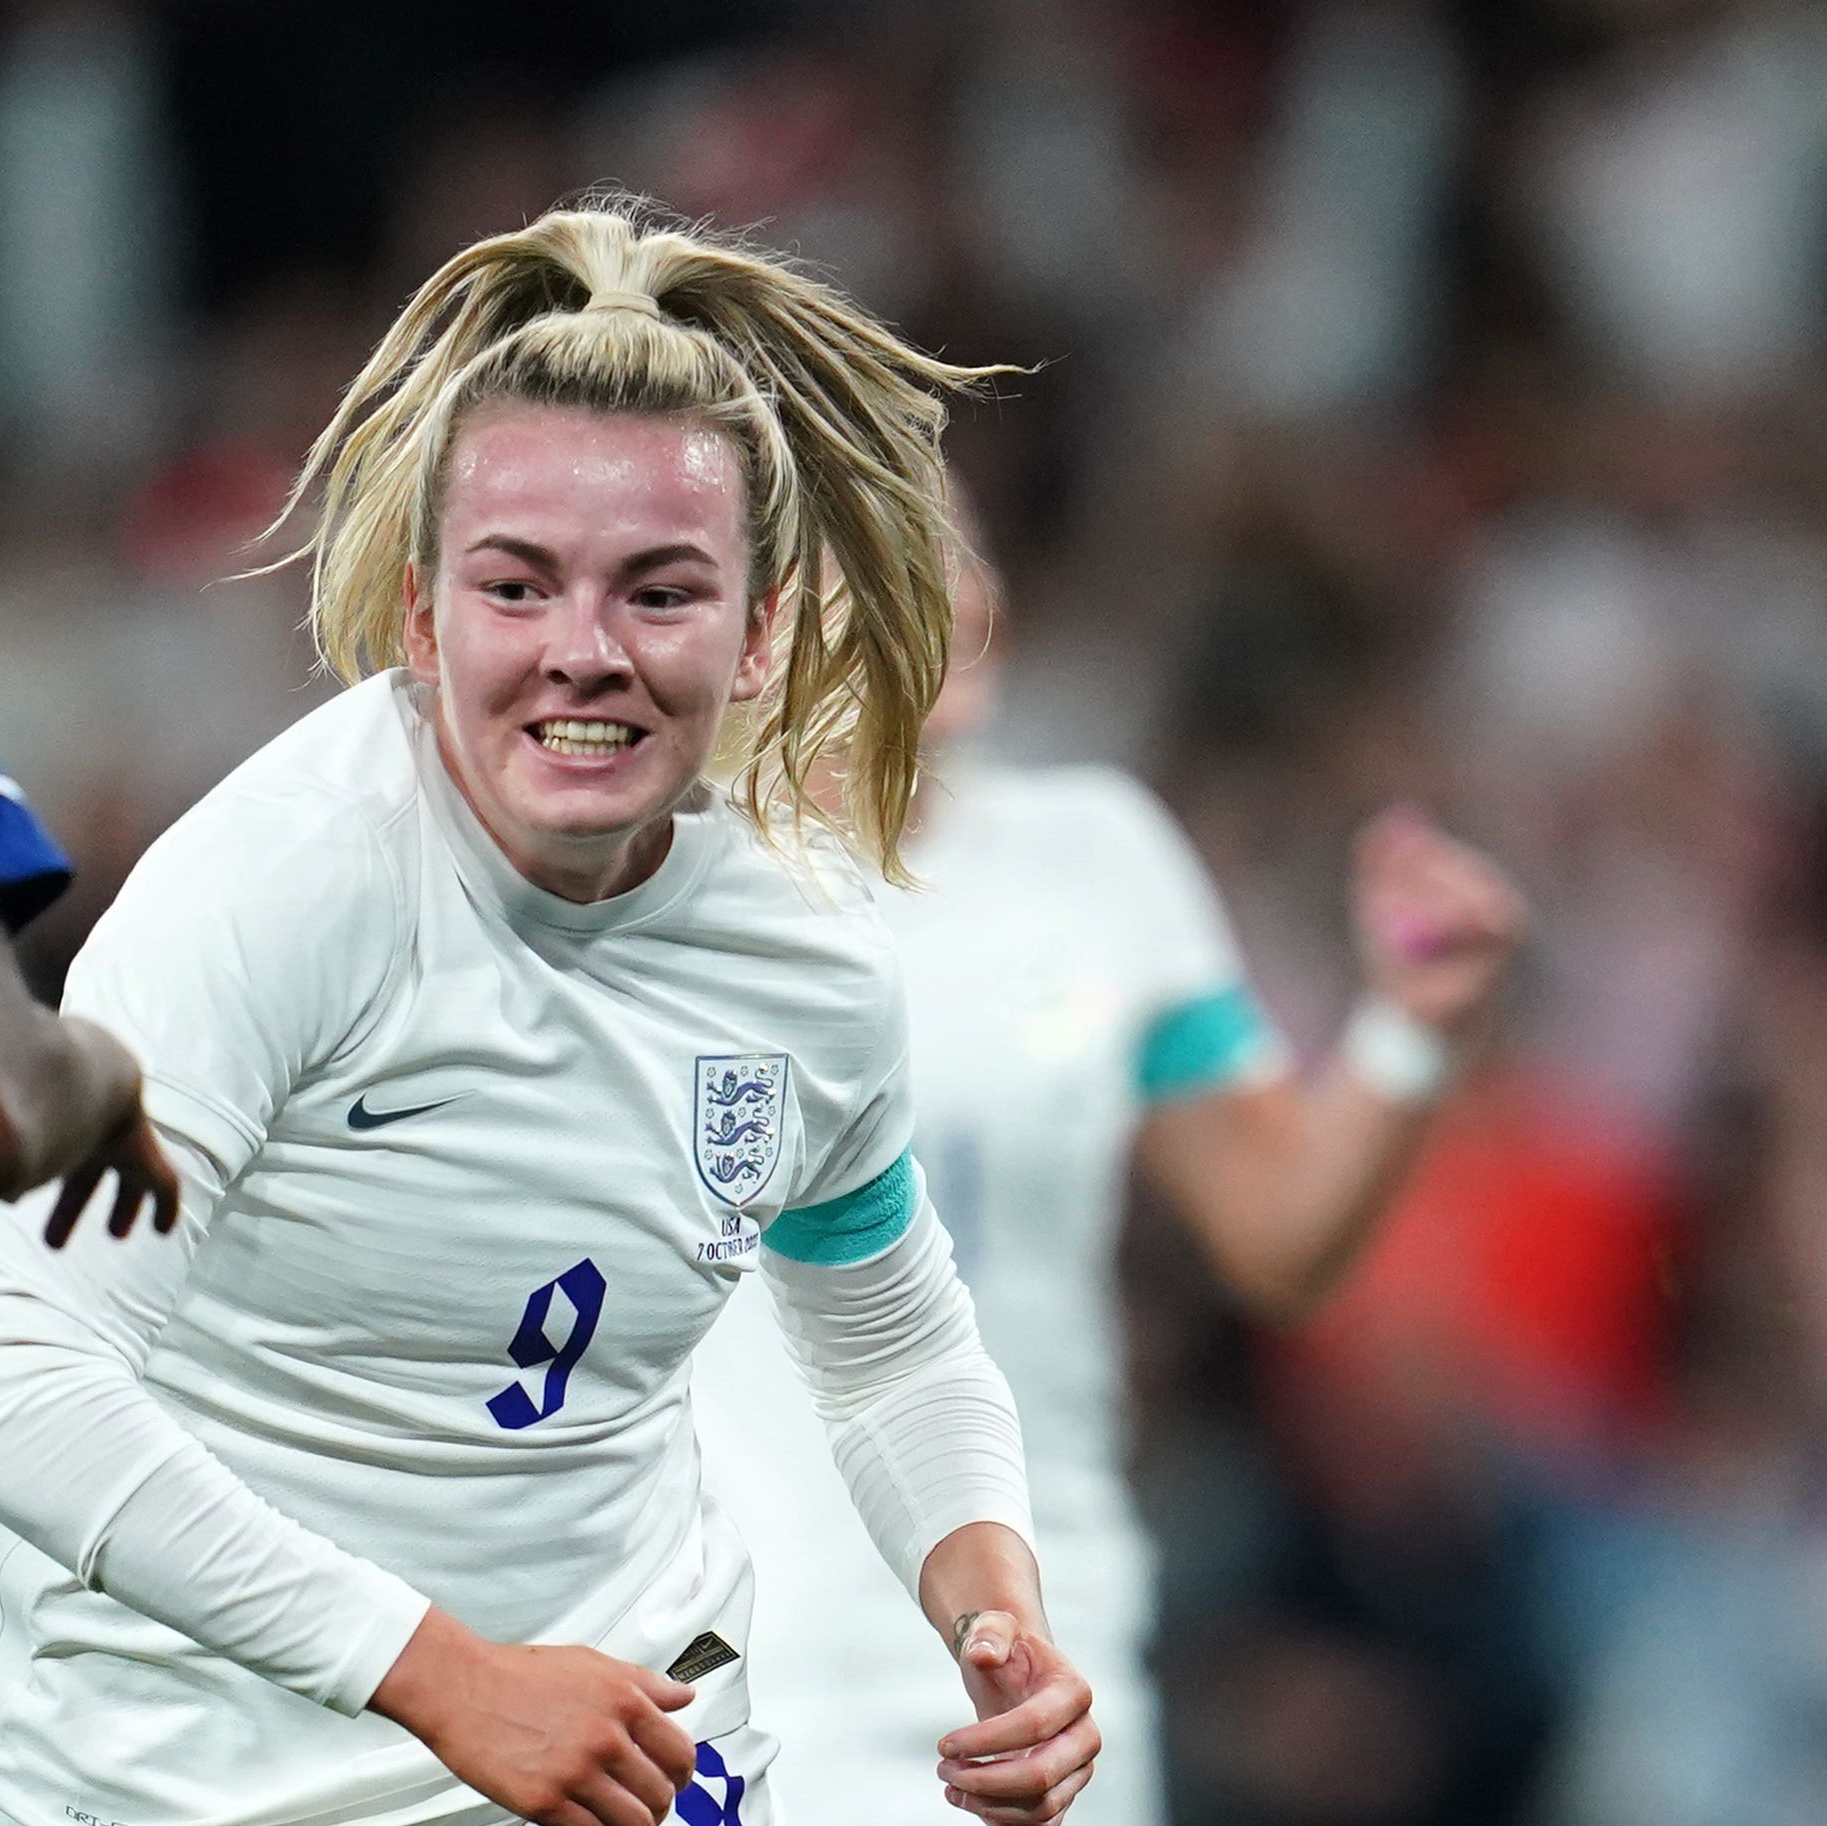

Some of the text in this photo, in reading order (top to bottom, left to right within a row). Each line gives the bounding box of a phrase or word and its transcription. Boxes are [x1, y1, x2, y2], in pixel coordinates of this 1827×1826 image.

[721, 1216, 741, 1237] USA
[697, 1242, 705, 1261] 7
[485, 1258, 607, 1430] 9
